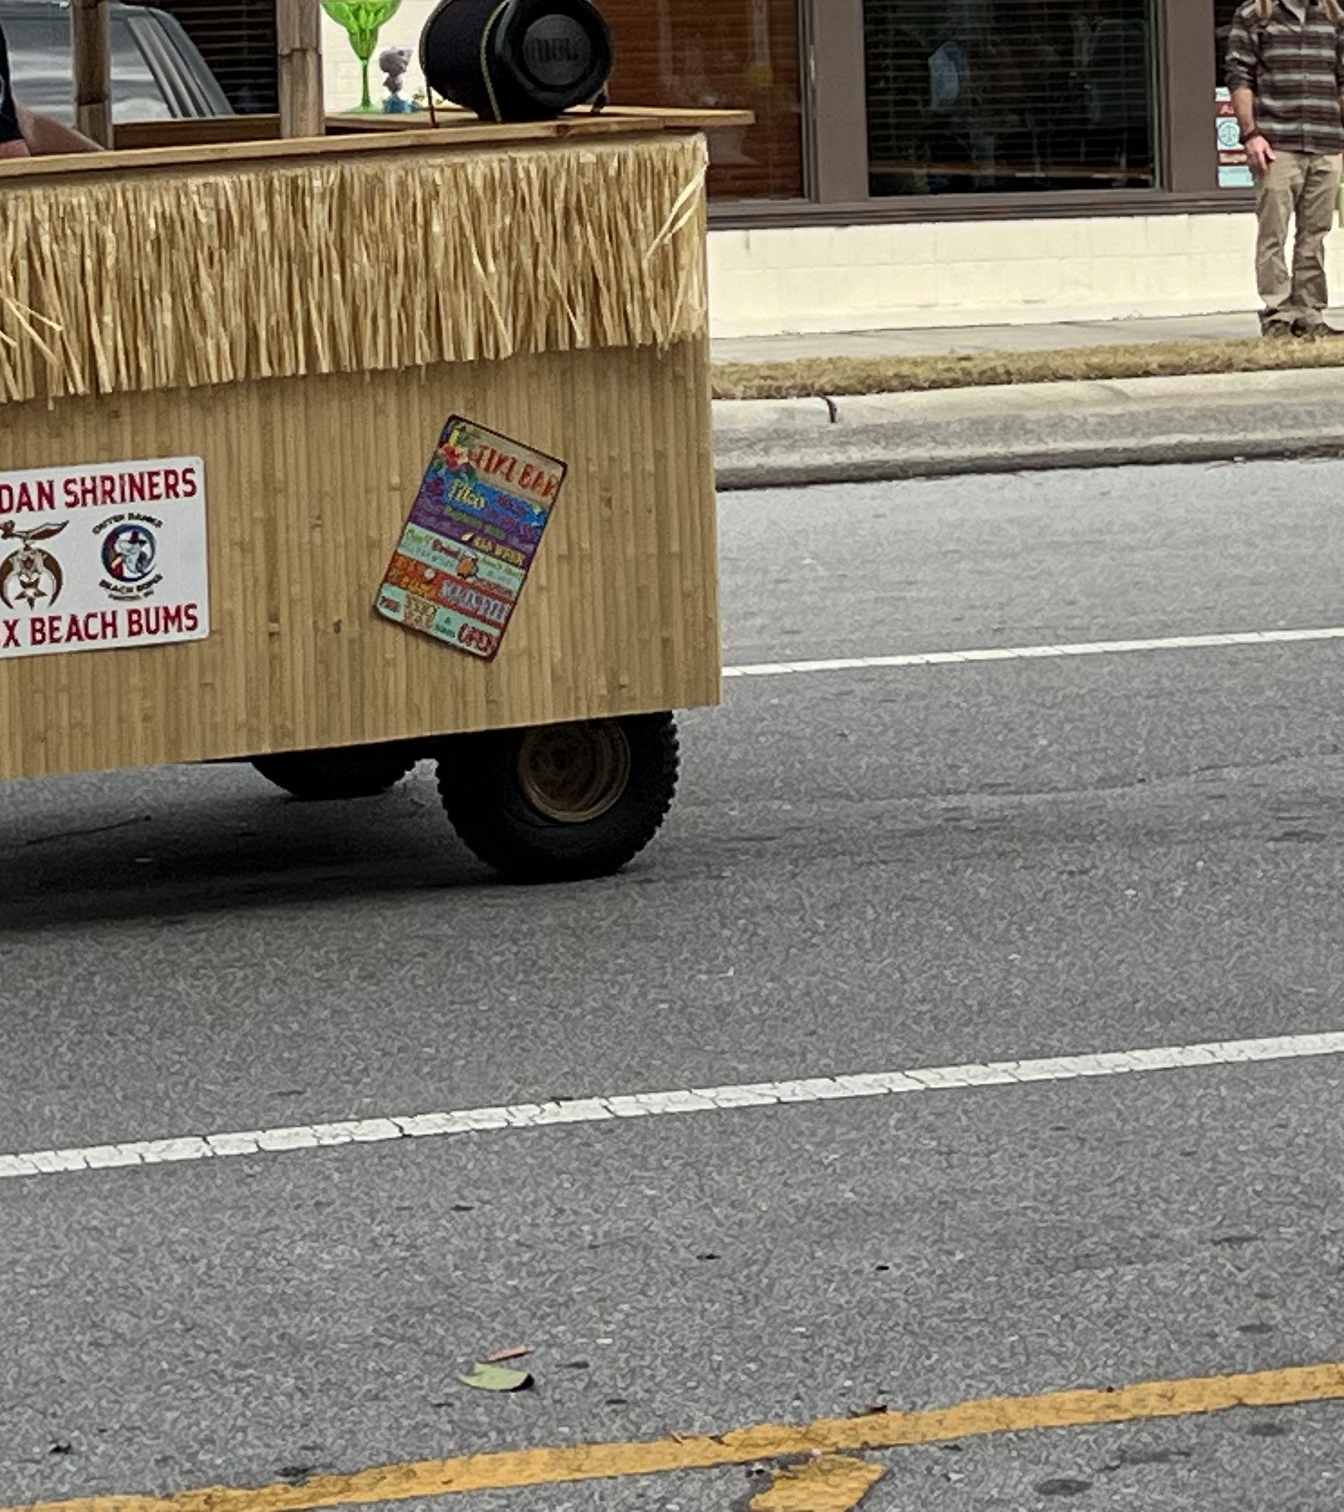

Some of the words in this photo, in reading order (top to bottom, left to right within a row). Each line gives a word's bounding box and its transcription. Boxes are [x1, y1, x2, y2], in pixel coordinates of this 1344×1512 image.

[63, 467, 198, 509] SHRINERS
[30, 608, 119, 646] BEACH
[127, 603, 199, 637] BUMS
